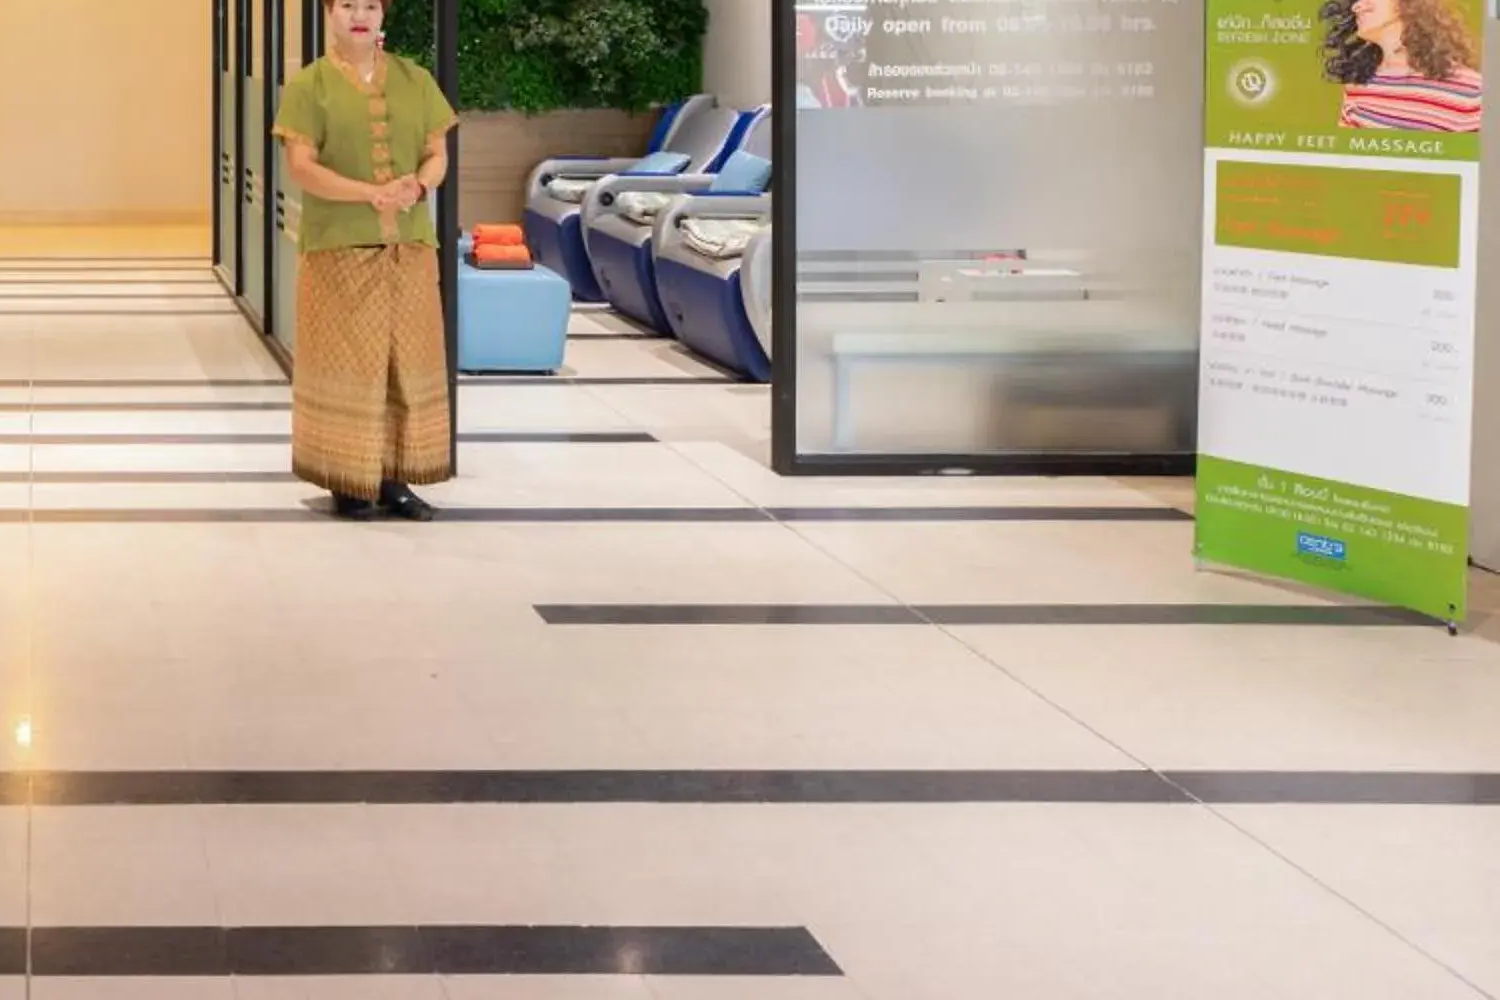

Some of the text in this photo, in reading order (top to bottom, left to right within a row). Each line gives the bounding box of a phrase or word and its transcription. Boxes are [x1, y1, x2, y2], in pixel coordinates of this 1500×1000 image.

[883, 18, 932, 36] open
[940, 16, 988, 34] from
[1228, 129, 1445, 155] HAPPY FEET MASSAGE
